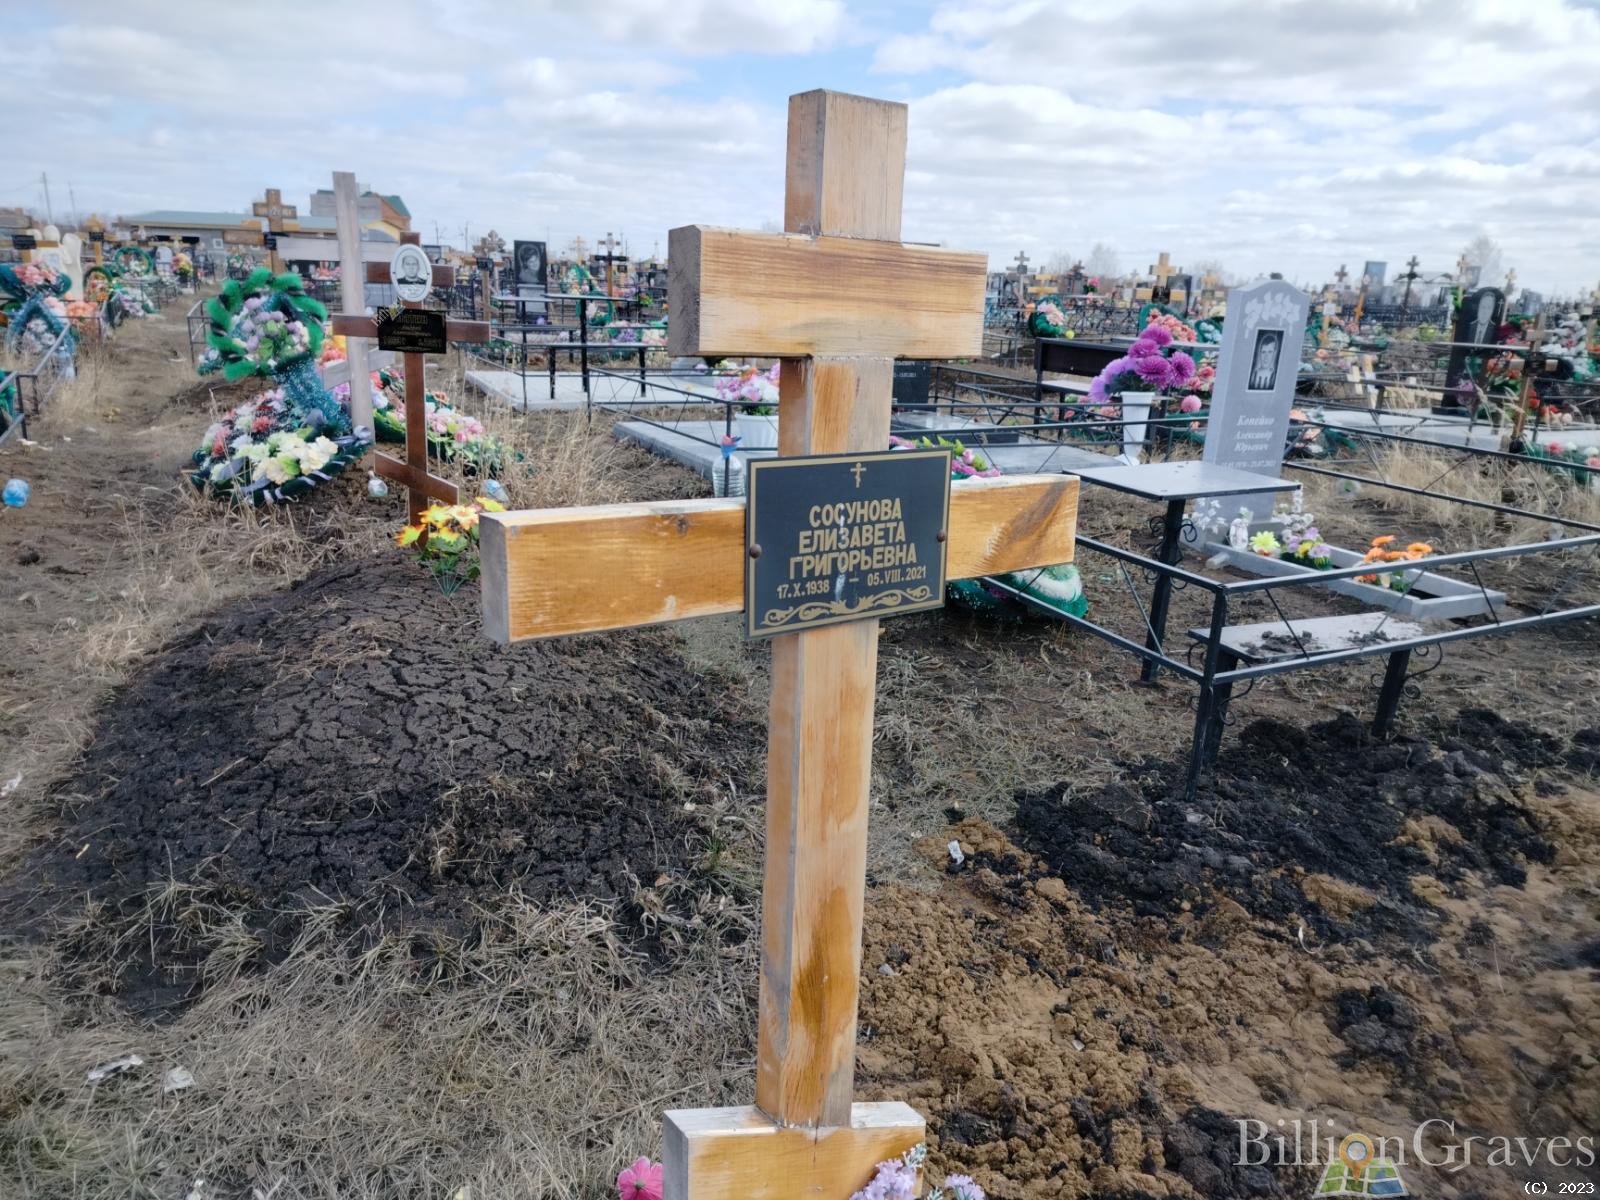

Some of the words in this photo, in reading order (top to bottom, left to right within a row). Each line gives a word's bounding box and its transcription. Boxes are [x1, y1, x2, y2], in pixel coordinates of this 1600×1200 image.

[809, 498, 902, 528] СОСУНОВА
[799, 521, 906, 554] ЕЛИЗАВЕТА
[789, 543, 917, 579] ГРИГОРЬЕВНА
[776, 579, 830, 599] 17.X.1938
[867, 565, 927, 587] 05.VIII.2021
